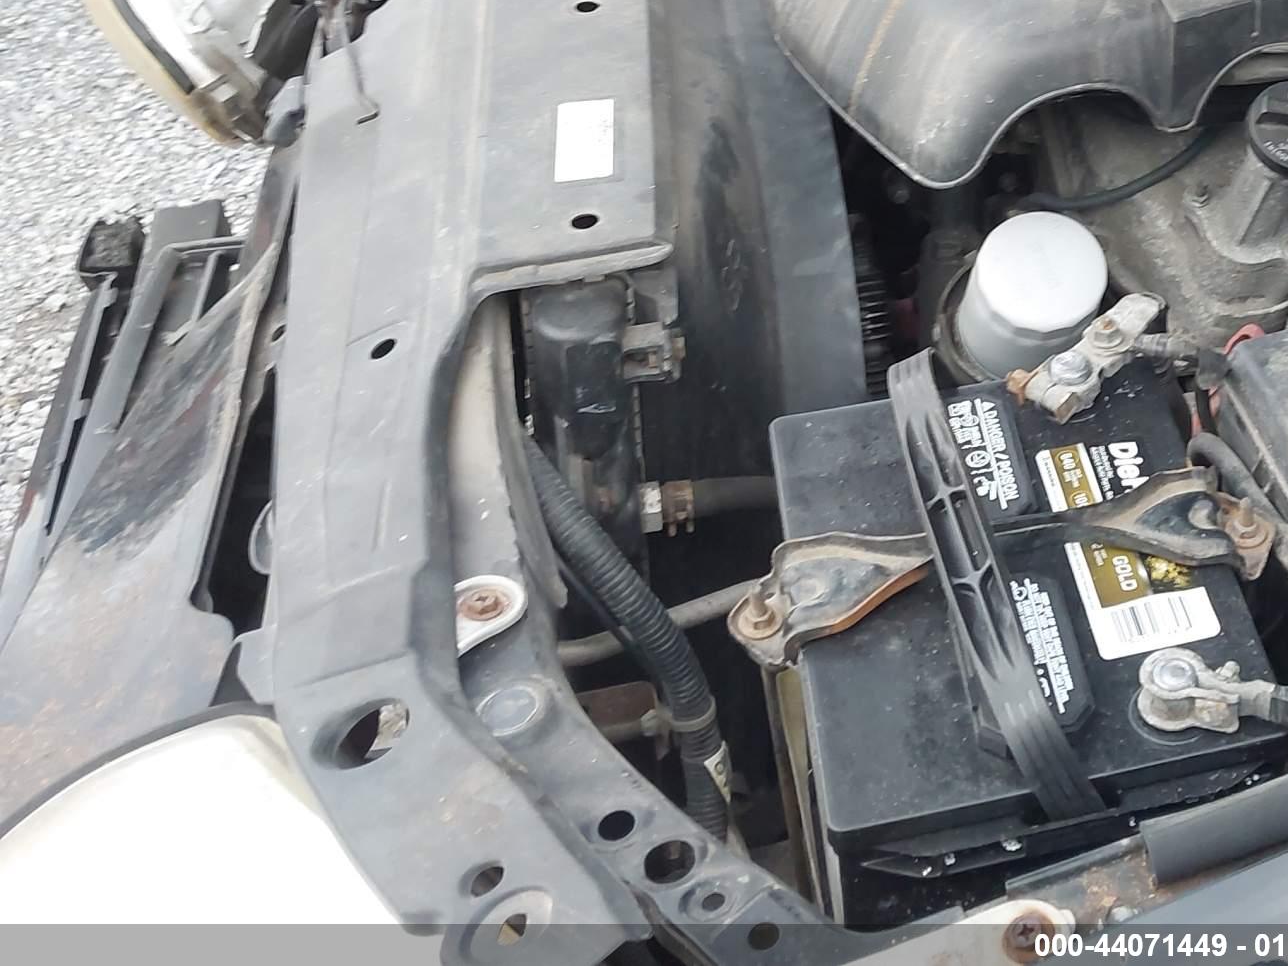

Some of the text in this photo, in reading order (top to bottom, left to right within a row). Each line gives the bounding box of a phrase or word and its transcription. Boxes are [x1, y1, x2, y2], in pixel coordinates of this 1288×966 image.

[983, 410, 1006, 453] DANGER
[996, 460, 1020, 501] POISON
[1112, 555, 1138, 592] GOLD
